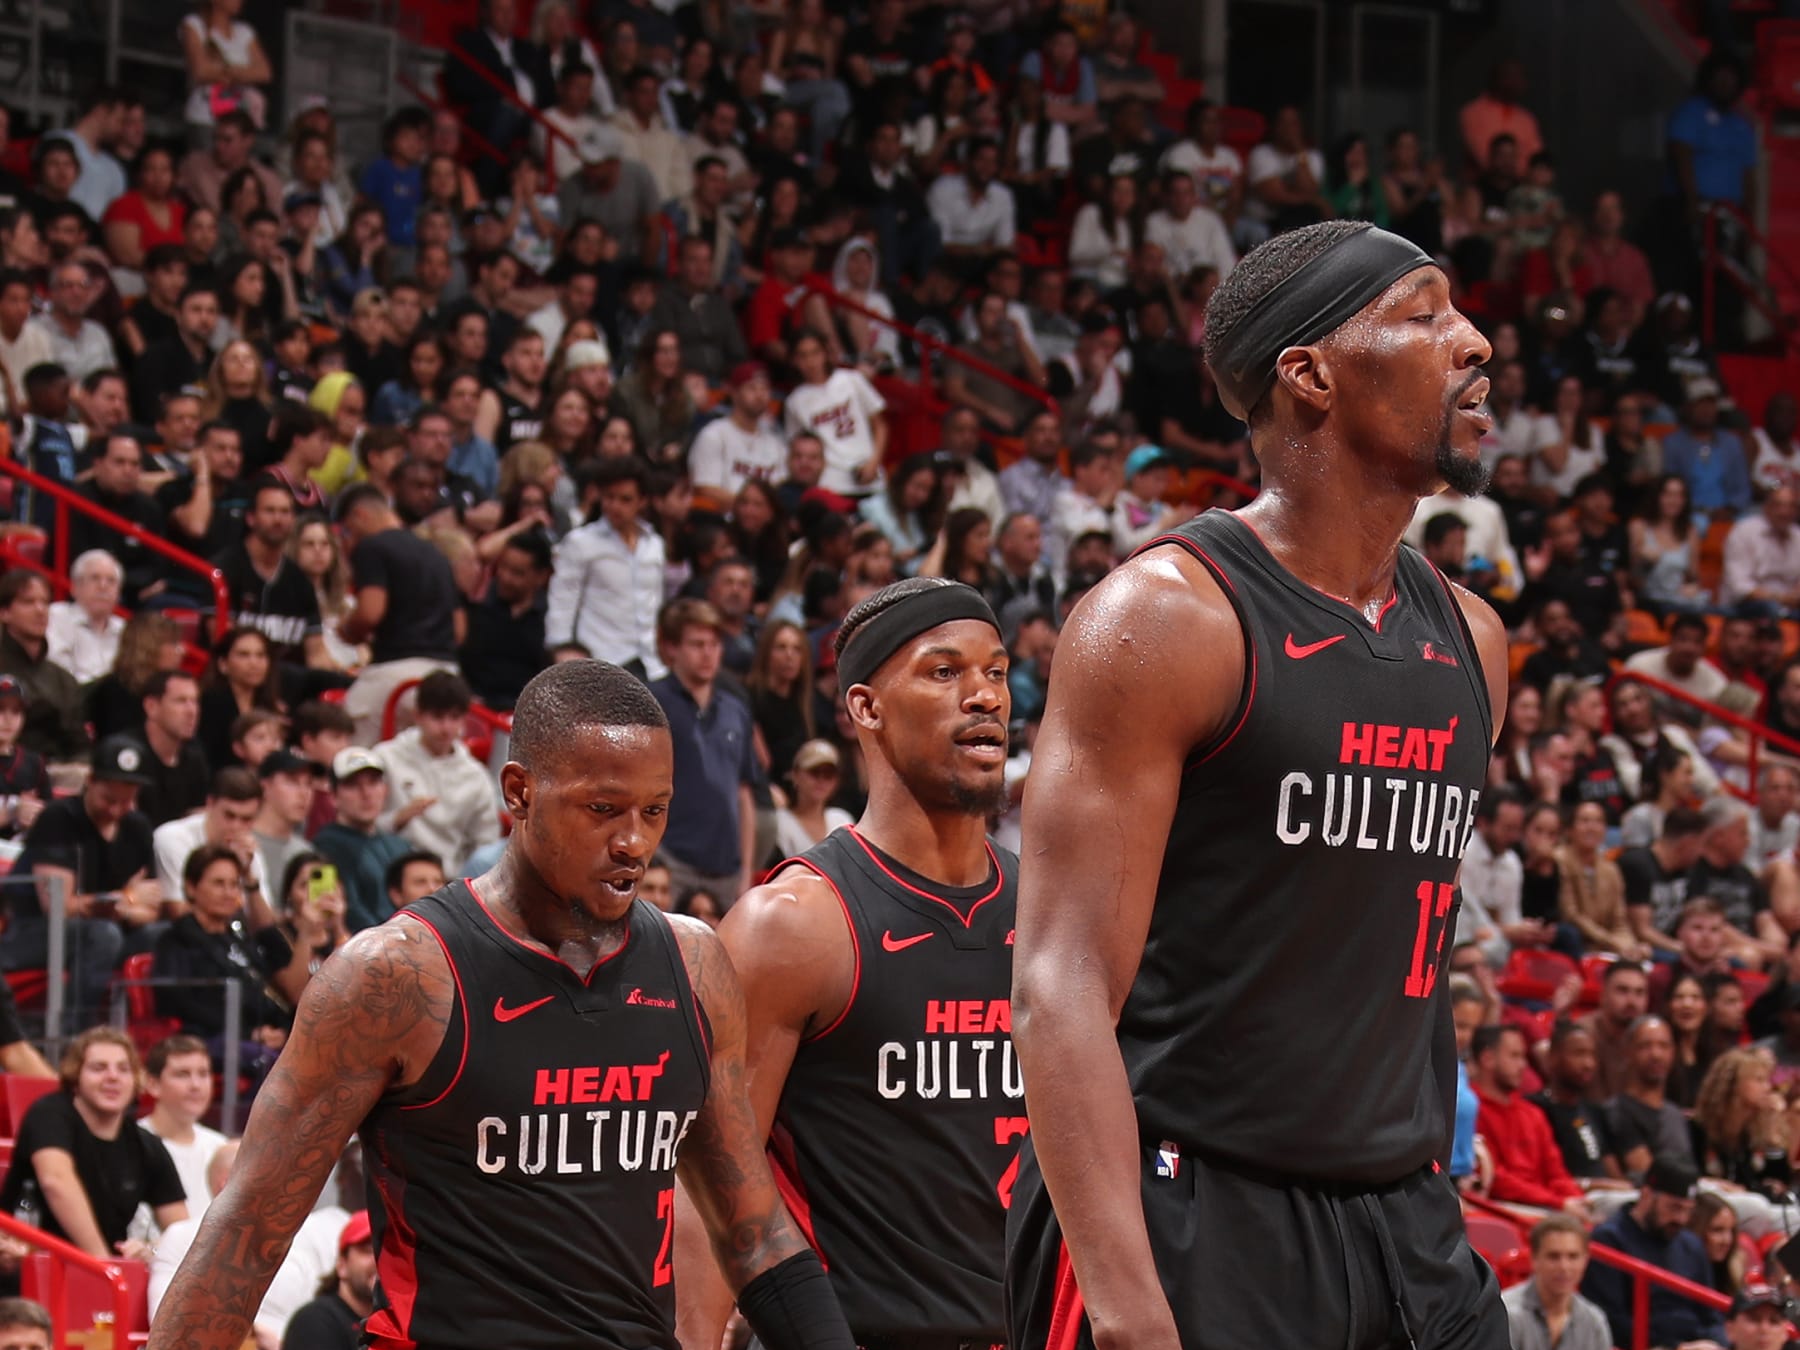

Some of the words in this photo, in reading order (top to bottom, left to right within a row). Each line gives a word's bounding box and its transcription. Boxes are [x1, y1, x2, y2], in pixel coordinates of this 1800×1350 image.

[1339, 715, 1459, 772] HEAT
[1276, 771, 1480, 860] CULTURE
[925, 1000, 1012, 1033] HEA
[533, 1050, 671, 1106] HEAT
[878, 1040, 1026, 1099] CULTU
[476, 1110, 698, 1175] CULTURE
[994, 1116, 1030, 1210] 2
